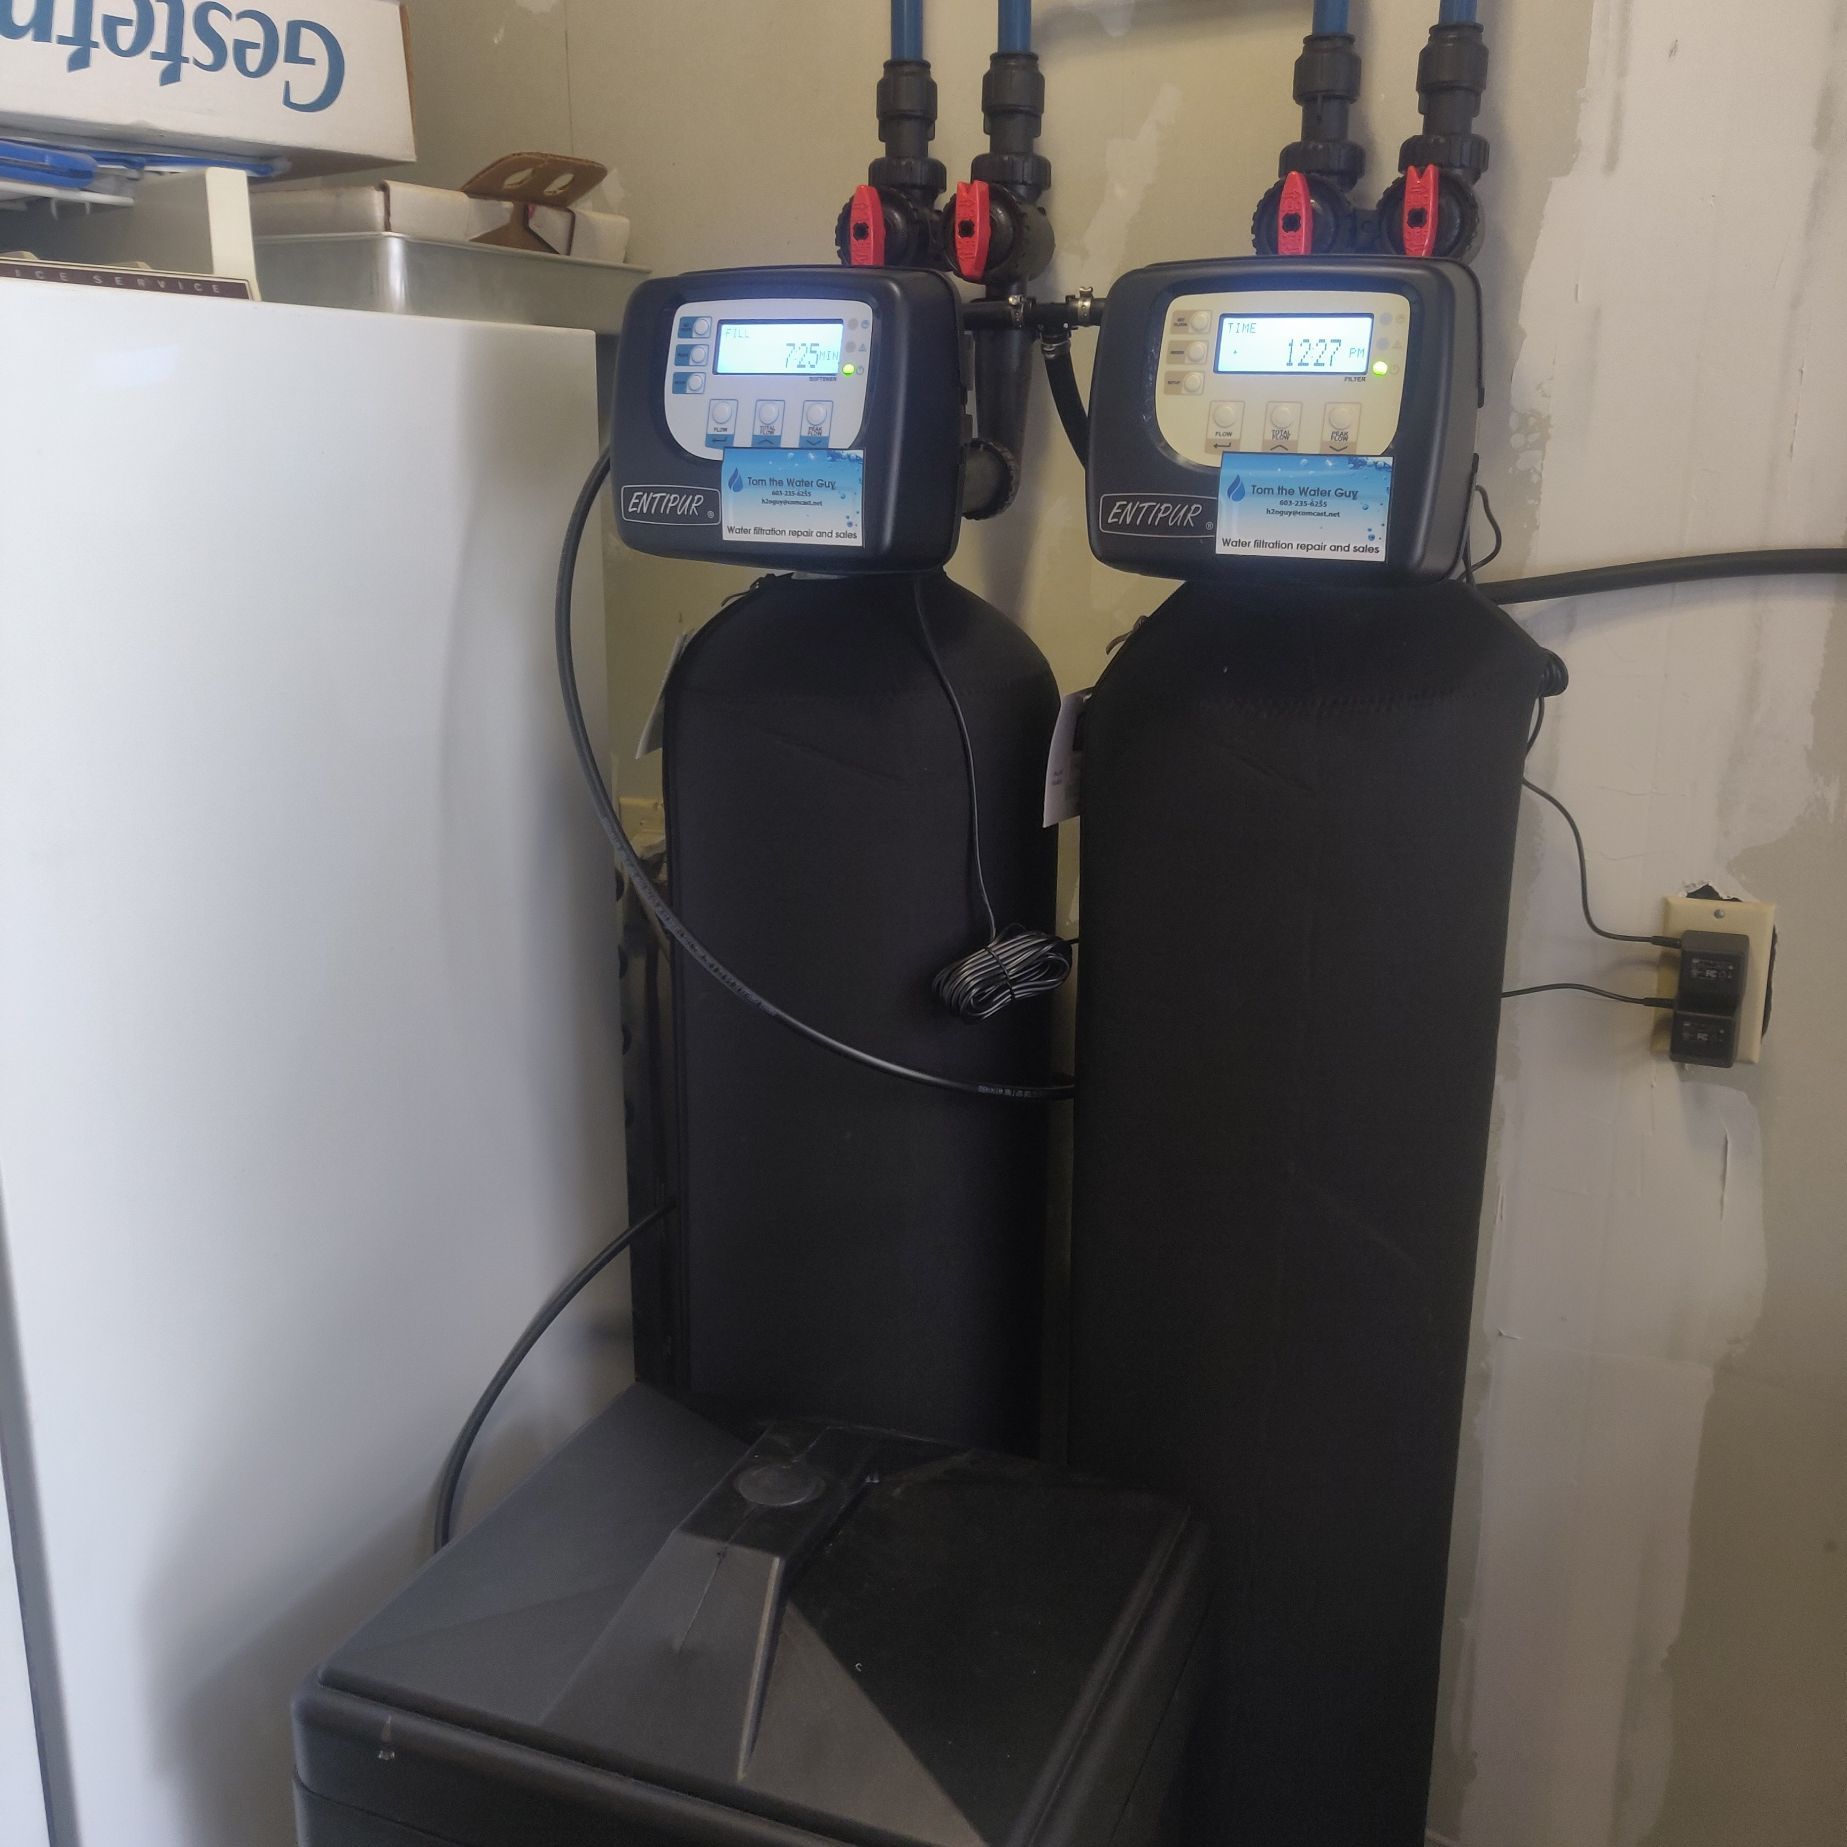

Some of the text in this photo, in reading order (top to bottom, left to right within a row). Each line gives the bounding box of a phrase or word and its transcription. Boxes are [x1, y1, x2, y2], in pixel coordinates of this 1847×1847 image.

[92, 275, 221, 294] SERVICE
[725, 328, 750, 339] FILL
[1227, 322, 1257, 334] TIME
[819, 350, 839, 361] MIN
[1349, 347, 1365, 358] PM
[747, 476, 837, 490] Tom the Water Guy
[1251, 484, 1359, 500] Tom the Water Guy
[627, 491, 704, 516] ENTIPUR
[1107, 499, 1203, 528] ENTIPUR
[727, 525, 857, 540] Water filtration repair and sales
[1222, 538, 1380, 554] Water filtration repair and sales
